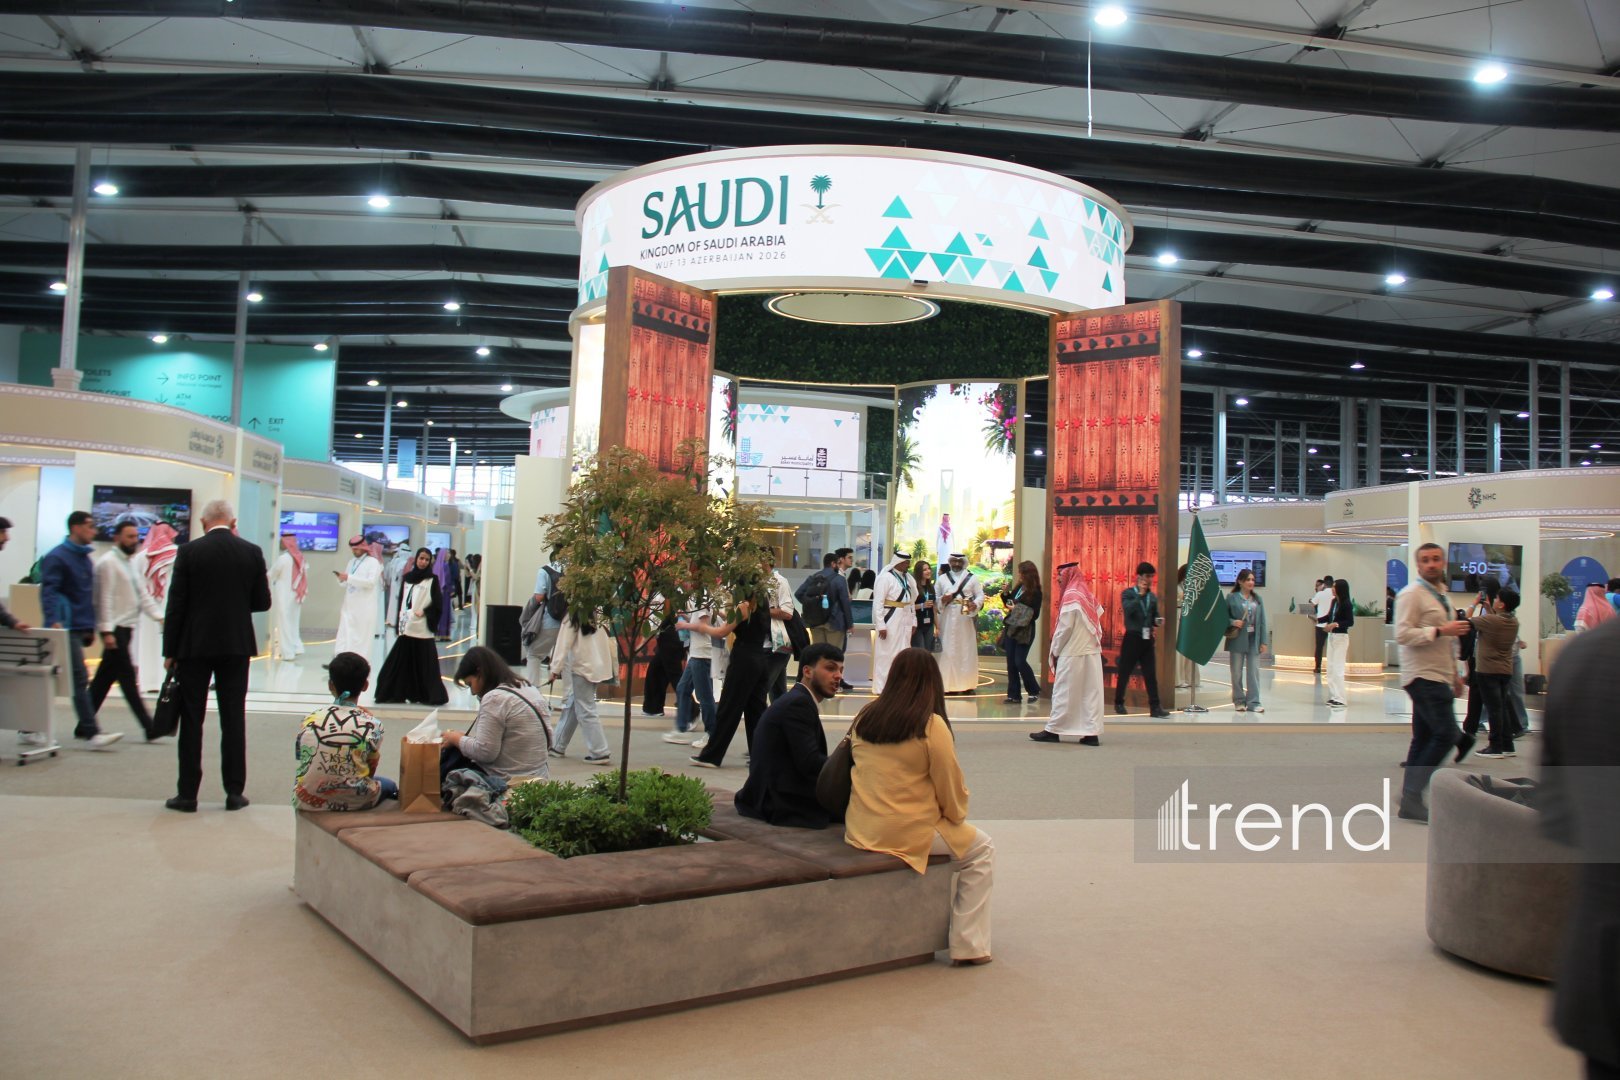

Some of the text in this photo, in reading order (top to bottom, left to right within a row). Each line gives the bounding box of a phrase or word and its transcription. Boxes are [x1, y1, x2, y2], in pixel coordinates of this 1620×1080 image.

[641, 175, 789, 239] SAUDI
[640, 235, 786, 260] KINGDOM OF SAUDI ARABIA
[655, 261, 674, 270] WUF
[690, 253, 753, 265] AZERBAIJAN
[759, 252, 786, 260] 2026
[1460, 561, 1487, 575] +50
